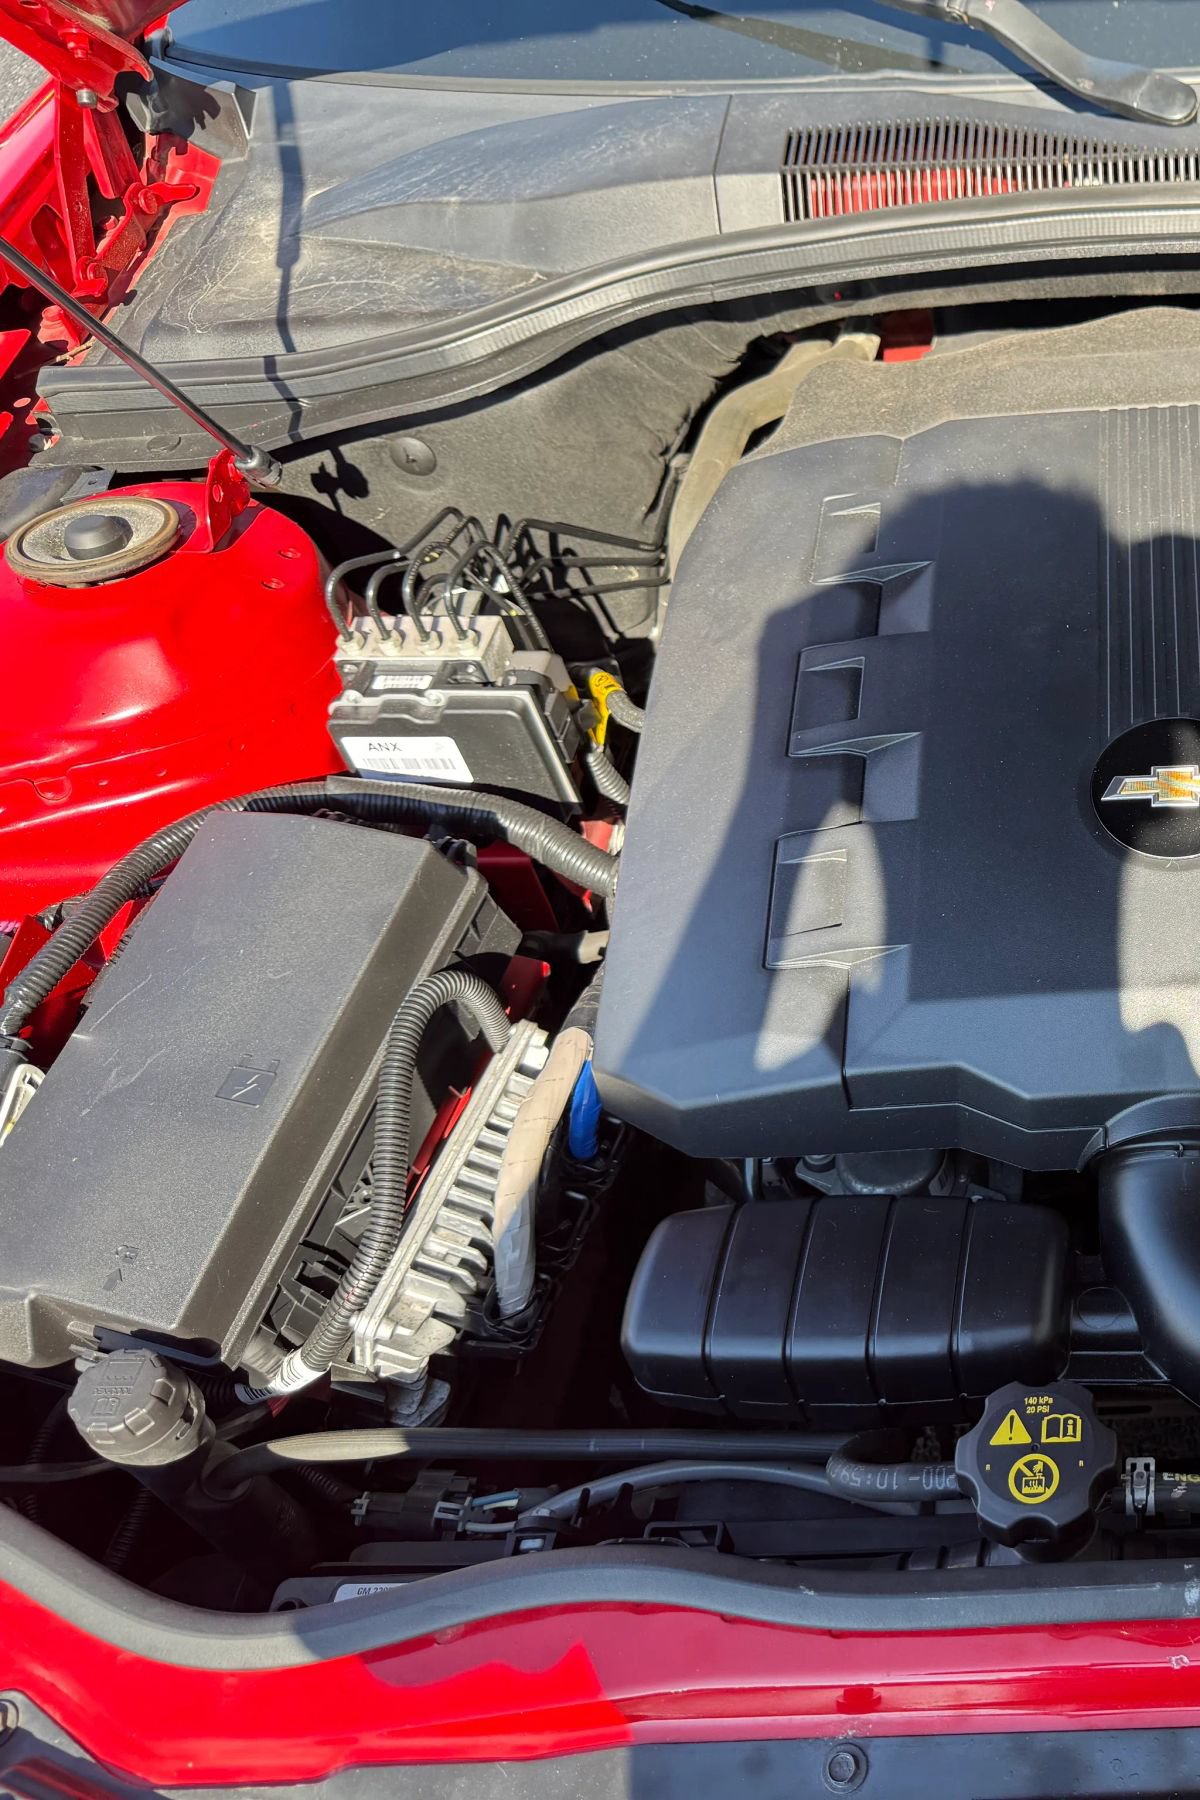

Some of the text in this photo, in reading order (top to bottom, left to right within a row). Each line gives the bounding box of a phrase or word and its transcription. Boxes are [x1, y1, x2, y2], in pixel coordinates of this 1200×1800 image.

[368, 742, 402, 752] ANX
[1023, 1395, 1054, 1405] 140 kPa
[1026, 1405, 1050, 1414] 20 PSI
